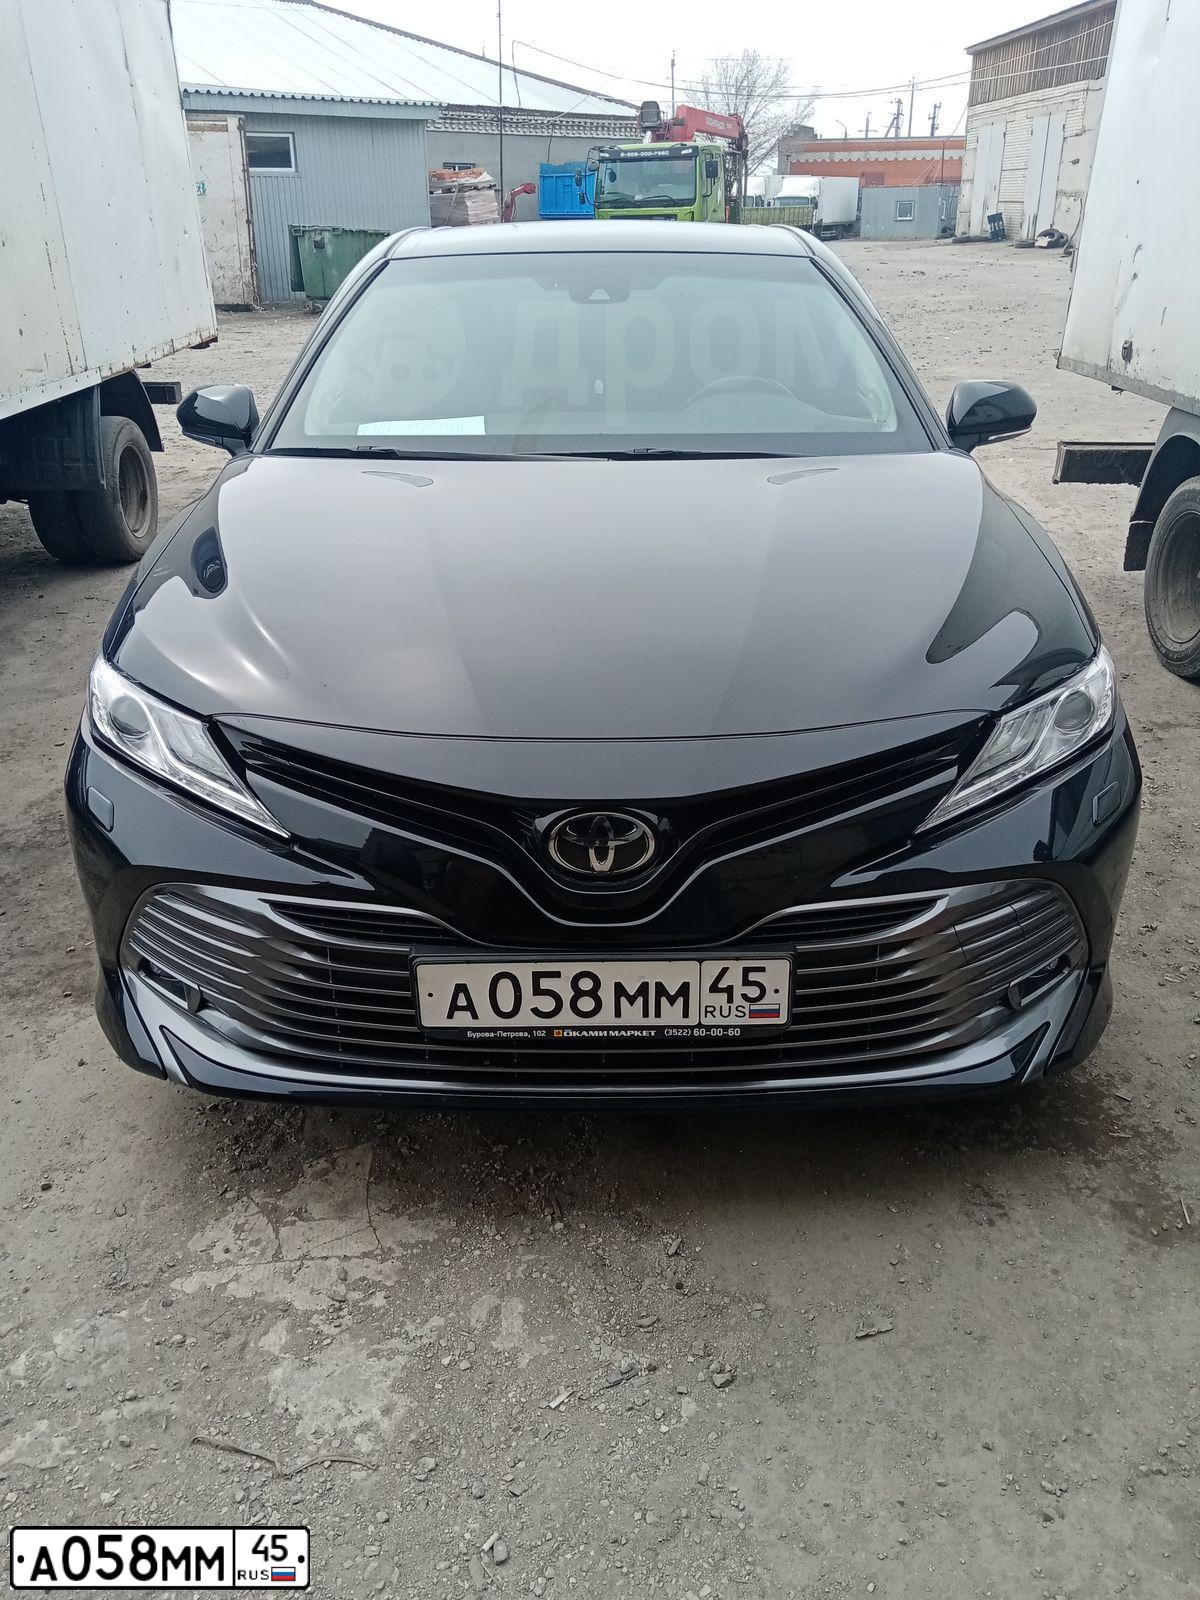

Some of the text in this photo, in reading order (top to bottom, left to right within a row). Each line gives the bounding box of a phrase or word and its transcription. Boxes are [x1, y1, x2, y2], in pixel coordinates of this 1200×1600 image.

[446, 966, 767, 1020] А058ММ 45
[704, 1004, 747, 1019] RUS
[467, 1030, 531, 1039] Бурова-Петрова,
[609, 1029, 657, 1037] МАРКЕТ
[664, 1028, 692, 1037] (3522)
[693, 1027, 741, 1037] 60-00-60
